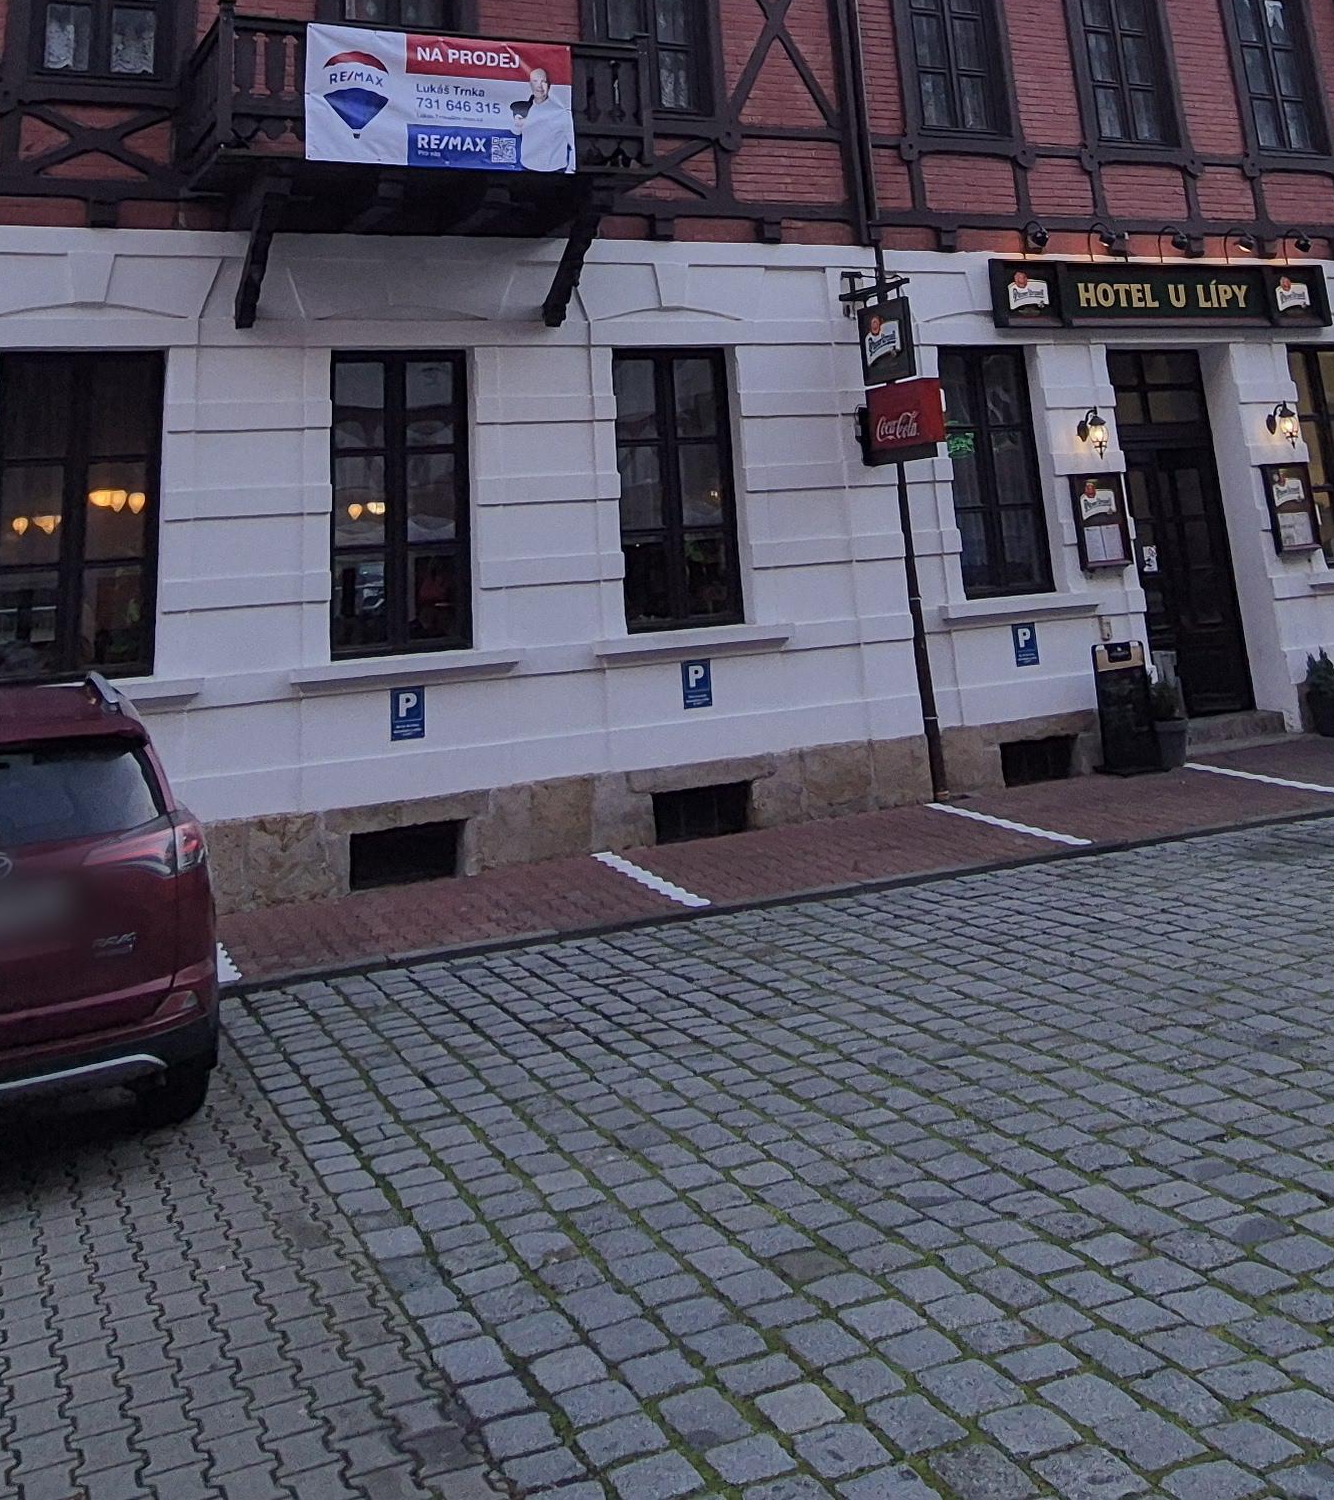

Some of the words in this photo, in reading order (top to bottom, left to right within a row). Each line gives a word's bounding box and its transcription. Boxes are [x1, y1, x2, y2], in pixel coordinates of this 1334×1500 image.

[416, 46, 443, 63] NA
[447, 48, 520, 69] PRODEJ
[329, 70, 383, 88] RE/MAX
[416, 83, 450, 95] Lukáš
[453, 85, 485, 97] Trnka
[416, 97, 440, 110] 731
[446, 99, 471, 113] 646
[475, 101, 501, 114] 315
[417, 133, 486, 153] RE/MAX
[1077, 282, 1159, 308] HOTEL
[1168, 284, 1187, 308] U
[1195, 279, 1249, 308] LÍPY
[1018, 627, 1031, 648] P
[688, 665, 704, 688] P
[398, 693, 417, 717] P
